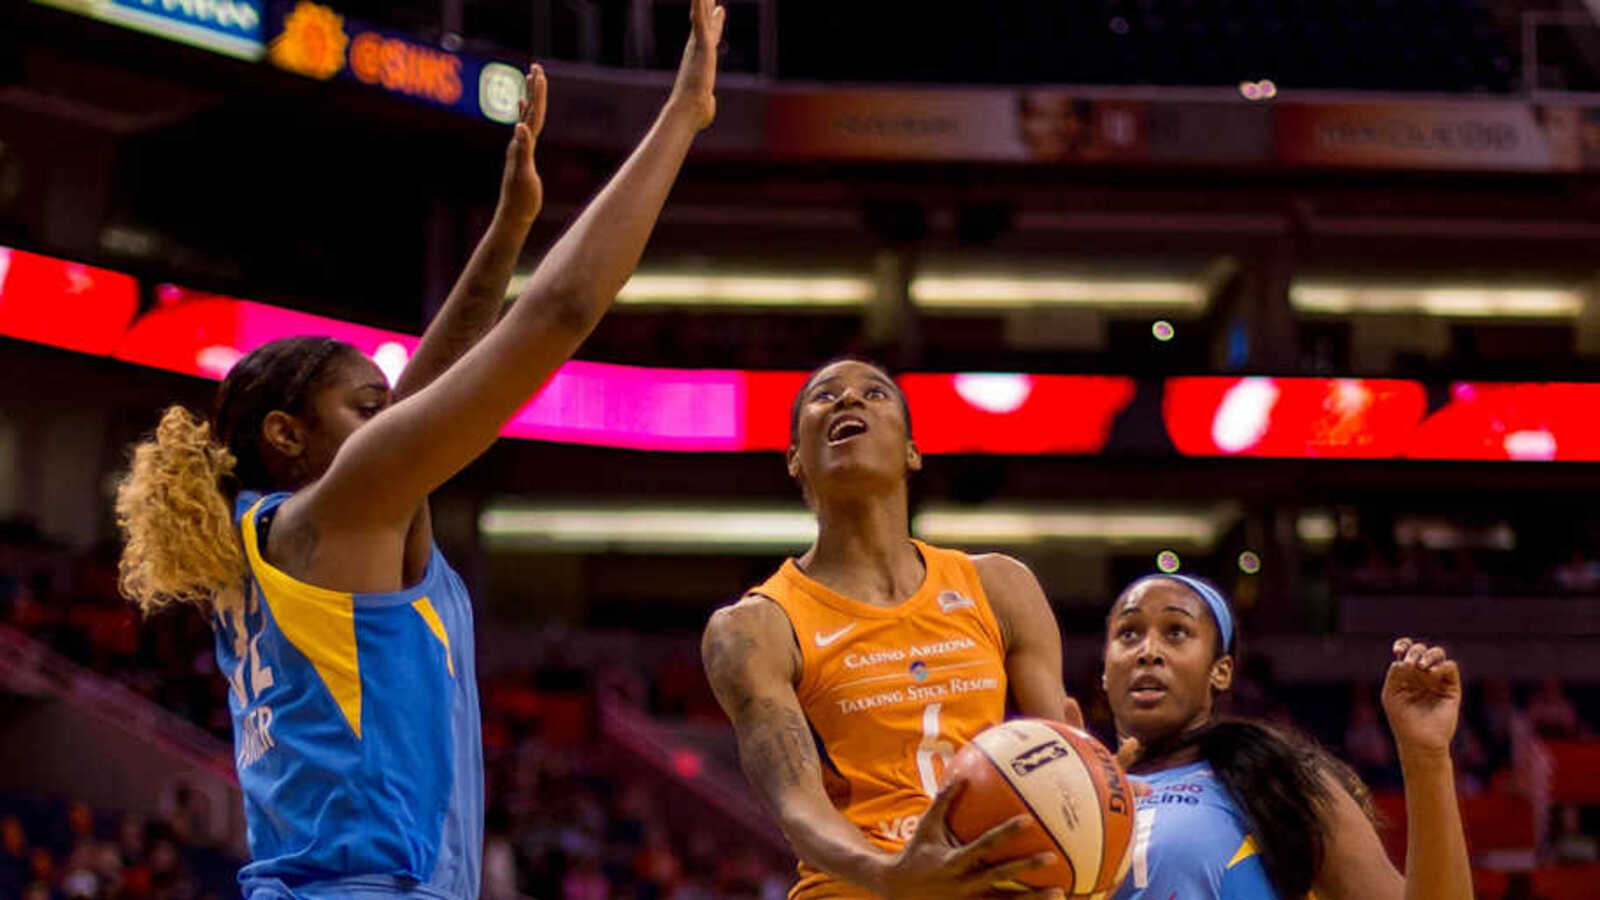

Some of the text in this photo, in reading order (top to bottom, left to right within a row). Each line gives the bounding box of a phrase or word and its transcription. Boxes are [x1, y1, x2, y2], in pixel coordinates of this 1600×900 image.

[843, 637, 976, 670] CASINO ARIZONA
[836, 677, 999, 715] TALKING STICK RESORT
